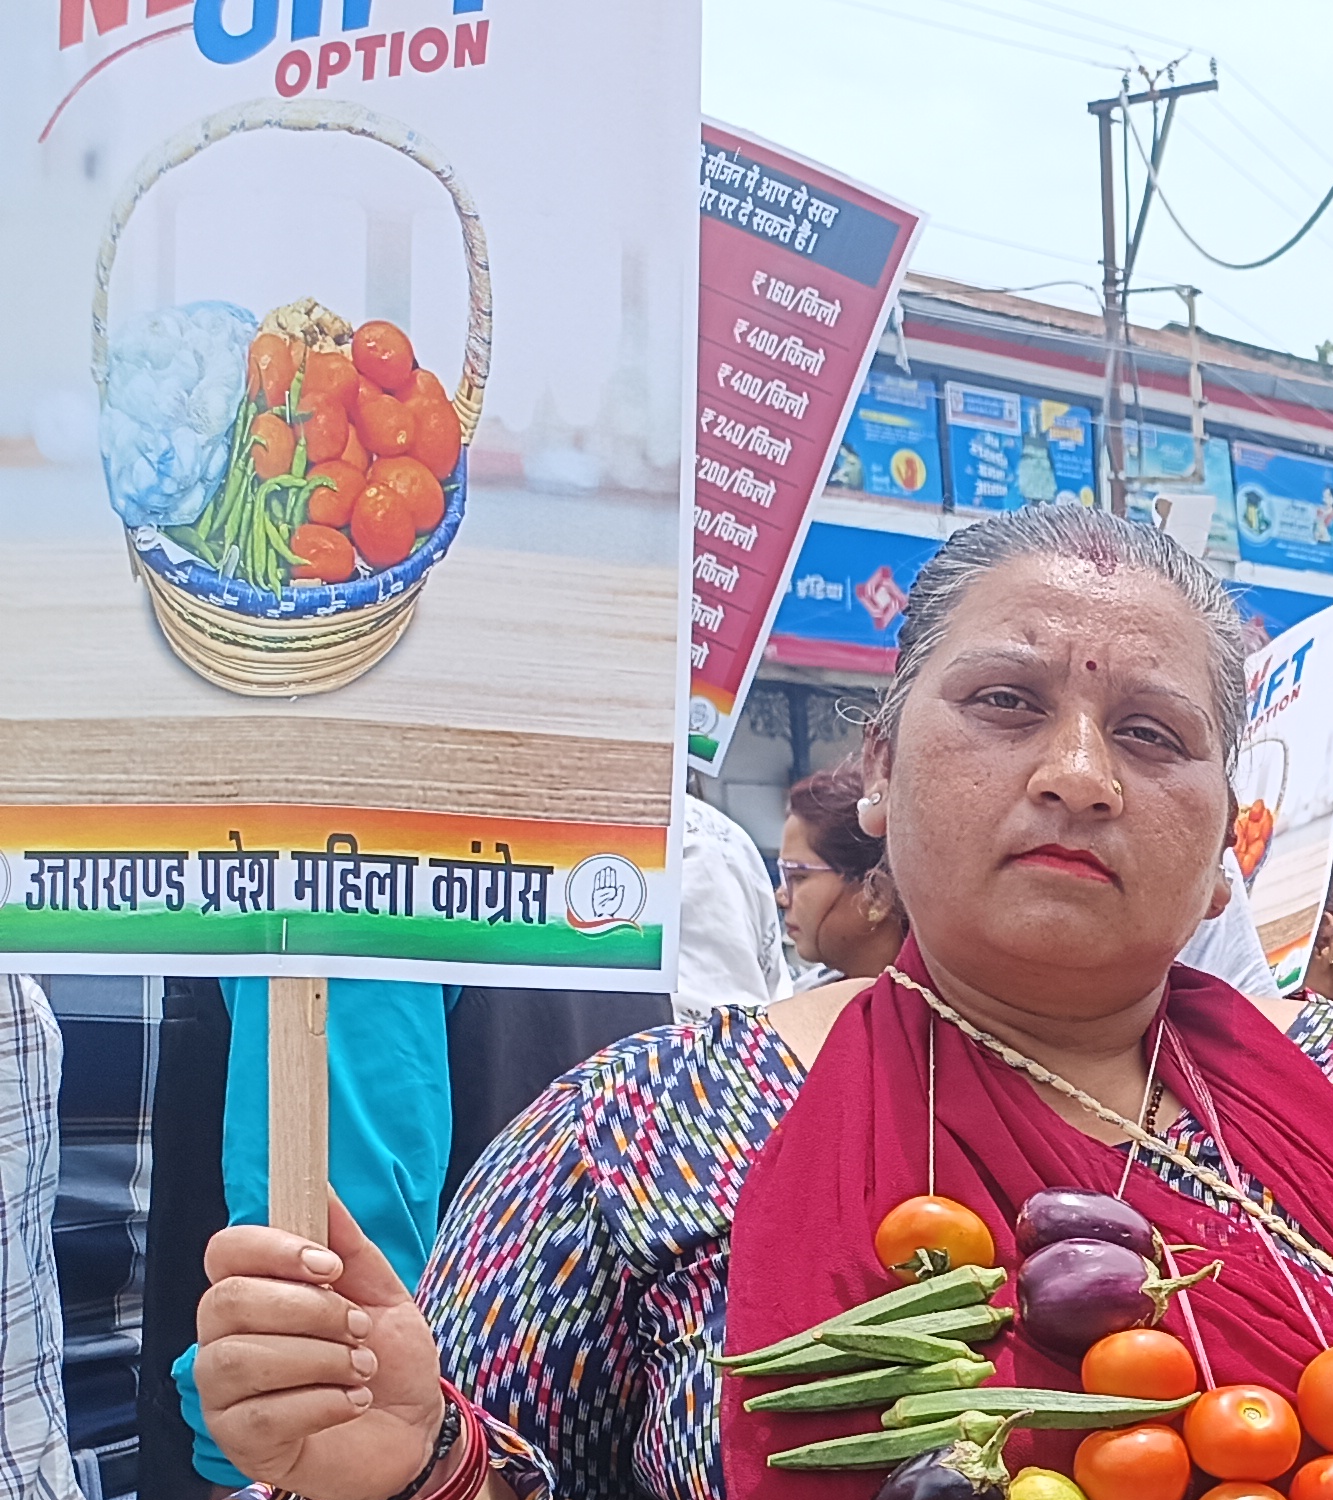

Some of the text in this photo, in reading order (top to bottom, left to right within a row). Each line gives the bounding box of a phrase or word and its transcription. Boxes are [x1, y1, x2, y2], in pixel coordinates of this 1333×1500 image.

[275, 19, 489, 98] OPTION
[705, 152, 745, 188] सीजन
[757, 176, 792, 207] आप
[792, 186, 808, 215] ये
[808, 197, 839, 228] सब
[719, 192, 739, 220] पर
[738, 196, 753, 225] दे
[752, 208, 796, 243] सकते
[1251, 637, 1314, 720] IFT
[25, 831, 553, 926] उत्तराखण्ड प्रदेश महिला कांग्रेस
